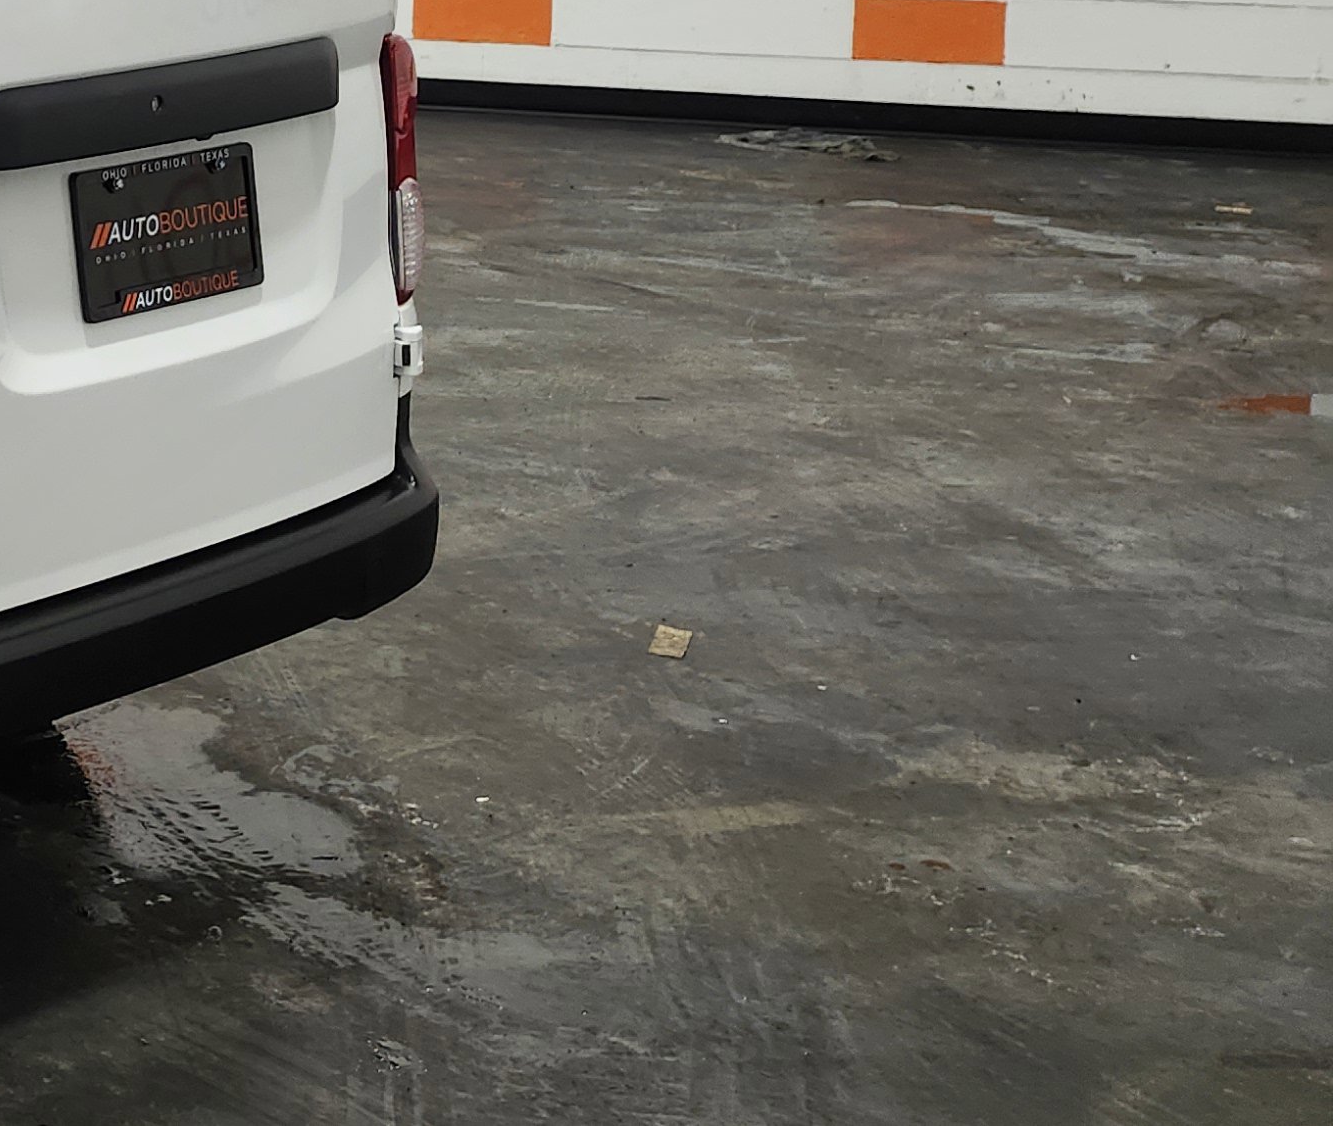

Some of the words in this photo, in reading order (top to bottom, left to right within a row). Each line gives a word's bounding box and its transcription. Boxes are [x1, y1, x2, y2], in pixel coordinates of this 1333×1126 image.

[102, 167, 128, 181] OHIO
[141, 157, 188, 174] FLORIDA
[200, 148, 231, 163] TEXAS
[107, 195, 249, 245] AUTOBOUTIQUE
[95, 250, 128, 265] OHIO
[140, 236, 196, 255] FLORIDA
[209, 226, 248, 241] TEXAS
[135, 270, 241, 310] AUTOBOUTIQUE
